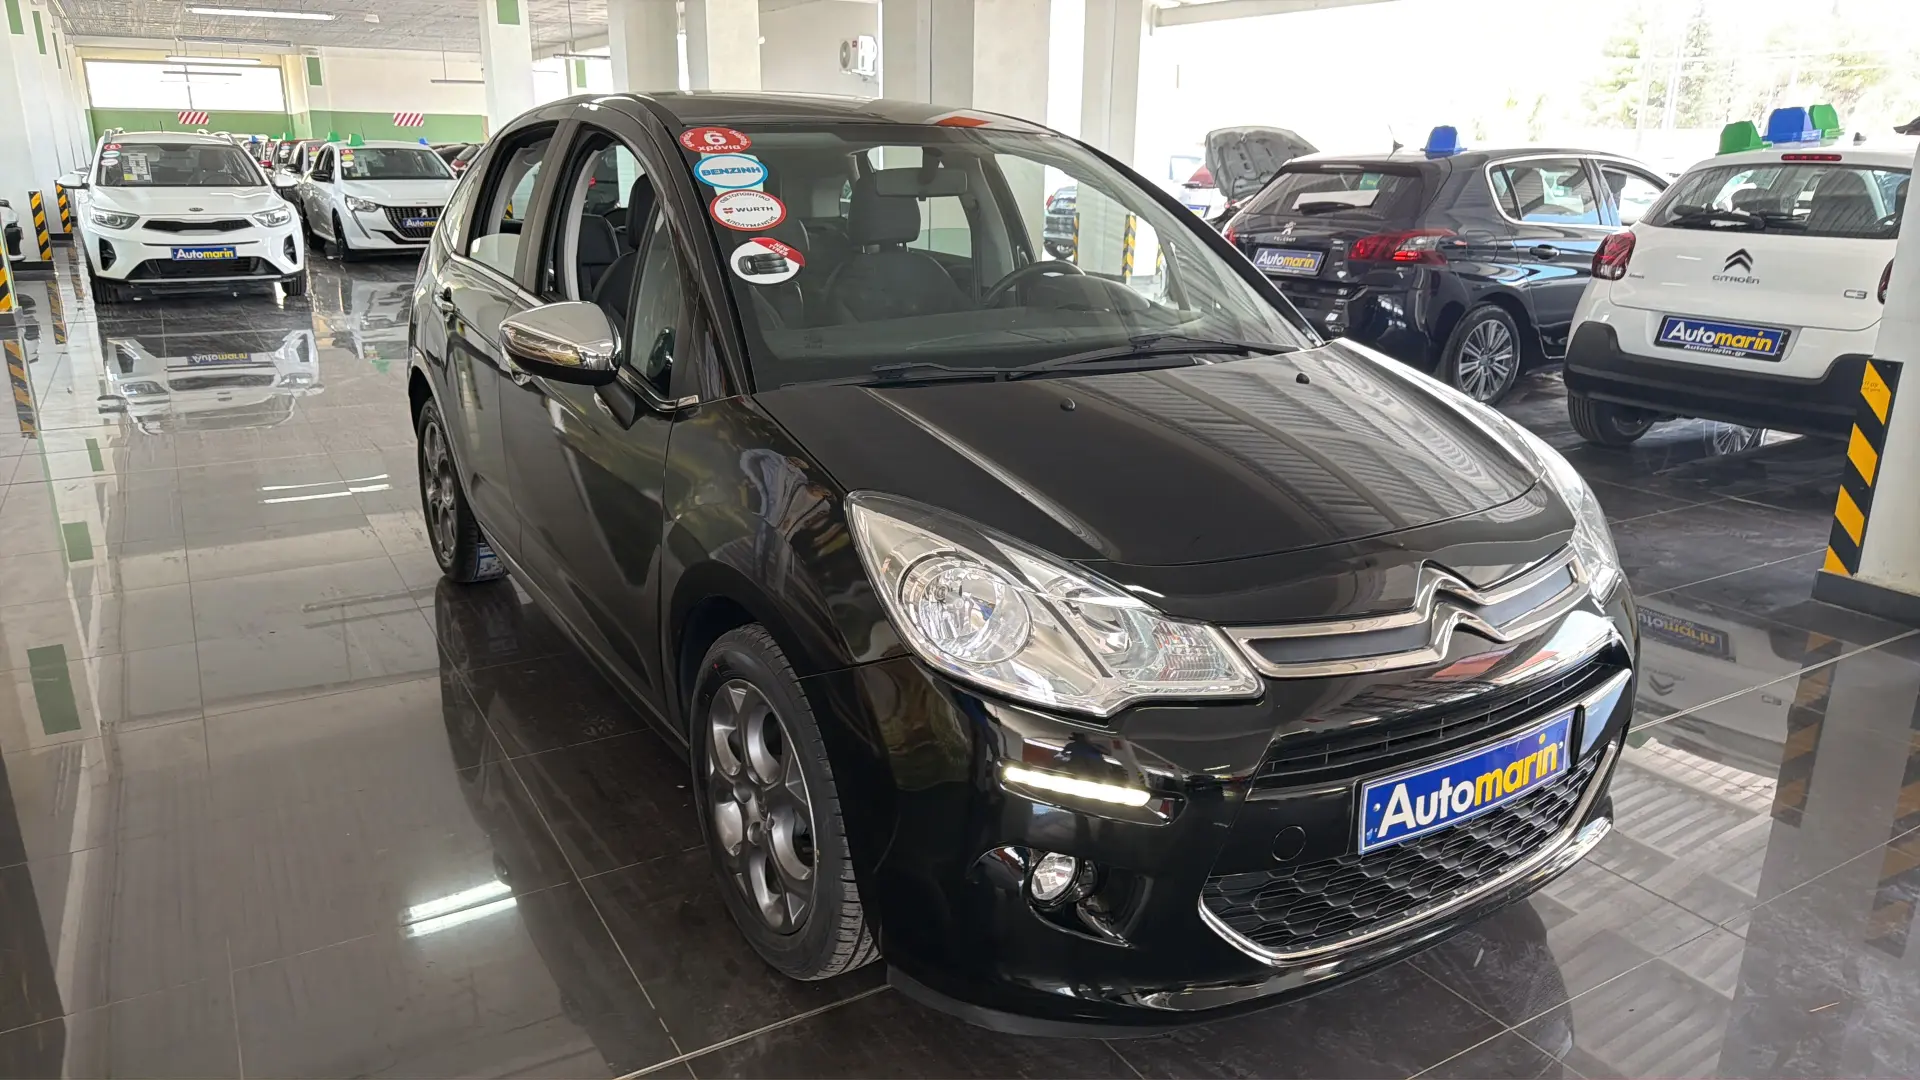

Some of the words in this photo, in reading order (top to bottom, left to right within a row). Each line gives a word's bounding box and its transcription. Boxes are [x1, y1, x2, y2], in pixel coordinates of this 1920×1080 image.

[704, 132, 727, 145] 6
[698, 144, 741, 152] χρόνια
[701, 166, 761, 177] ΒΕΝΖΙΝΗ
[406, 218, 437, 228] Automa
[176, 247, 234, 259] Automarin
[768, 243, 788, 256] TYRES
[774, 242, 790, 252] NEW
[1256, 250, 1315, 269] Automarin
[1843, 289, 1868, 300] C3
[1667, 321, 1773, 352] Automarin
[1683, 344, 1747, 357] Automarin.gr
[1376, 732, 1558, 839] Automarin
